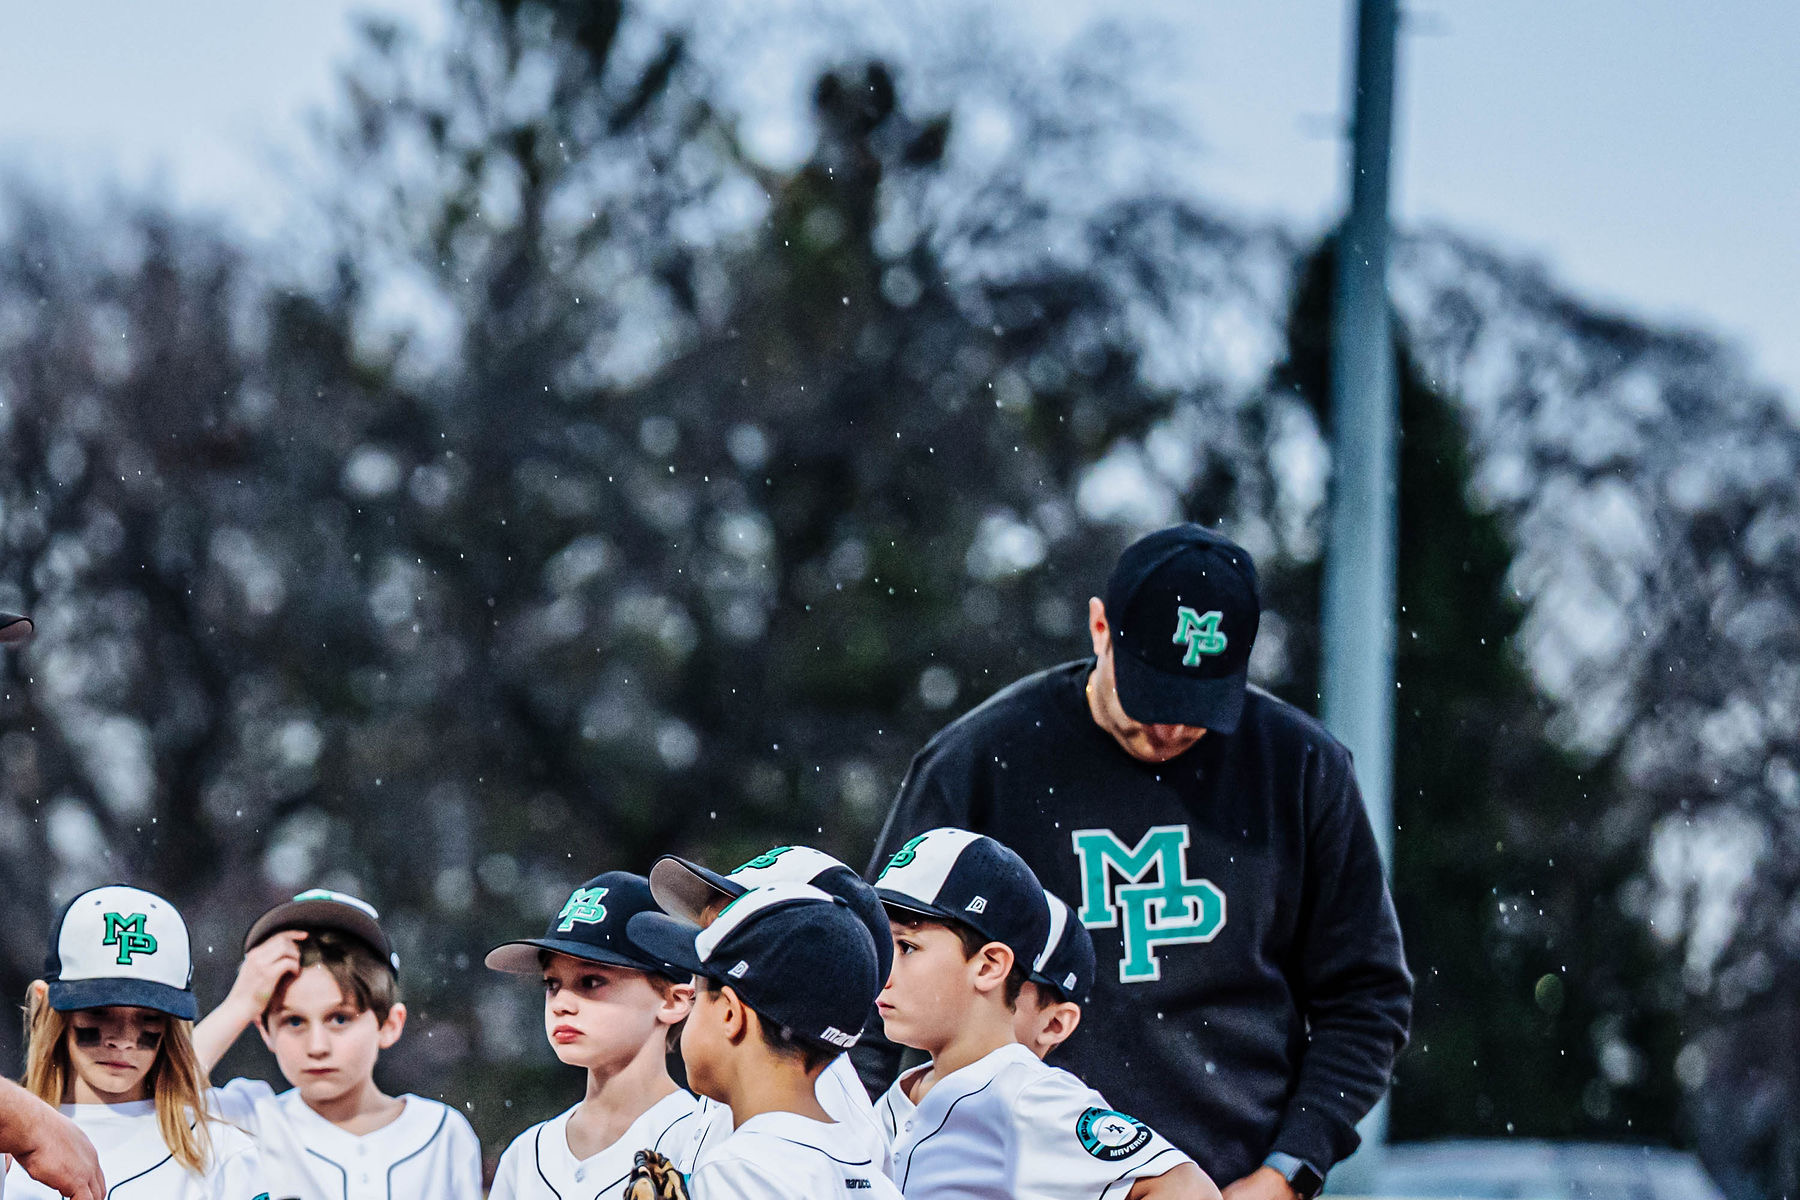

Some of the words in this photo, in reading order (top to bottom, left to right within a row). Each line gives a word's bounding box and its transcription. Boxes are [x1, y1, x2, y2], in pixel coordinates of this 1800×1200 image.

[1172, 605, 1228, 667] MP
[557, 887, 610, 932] MP
[1071, 824, 1227, 983] MP
[103, 912, 158, 965] MP
